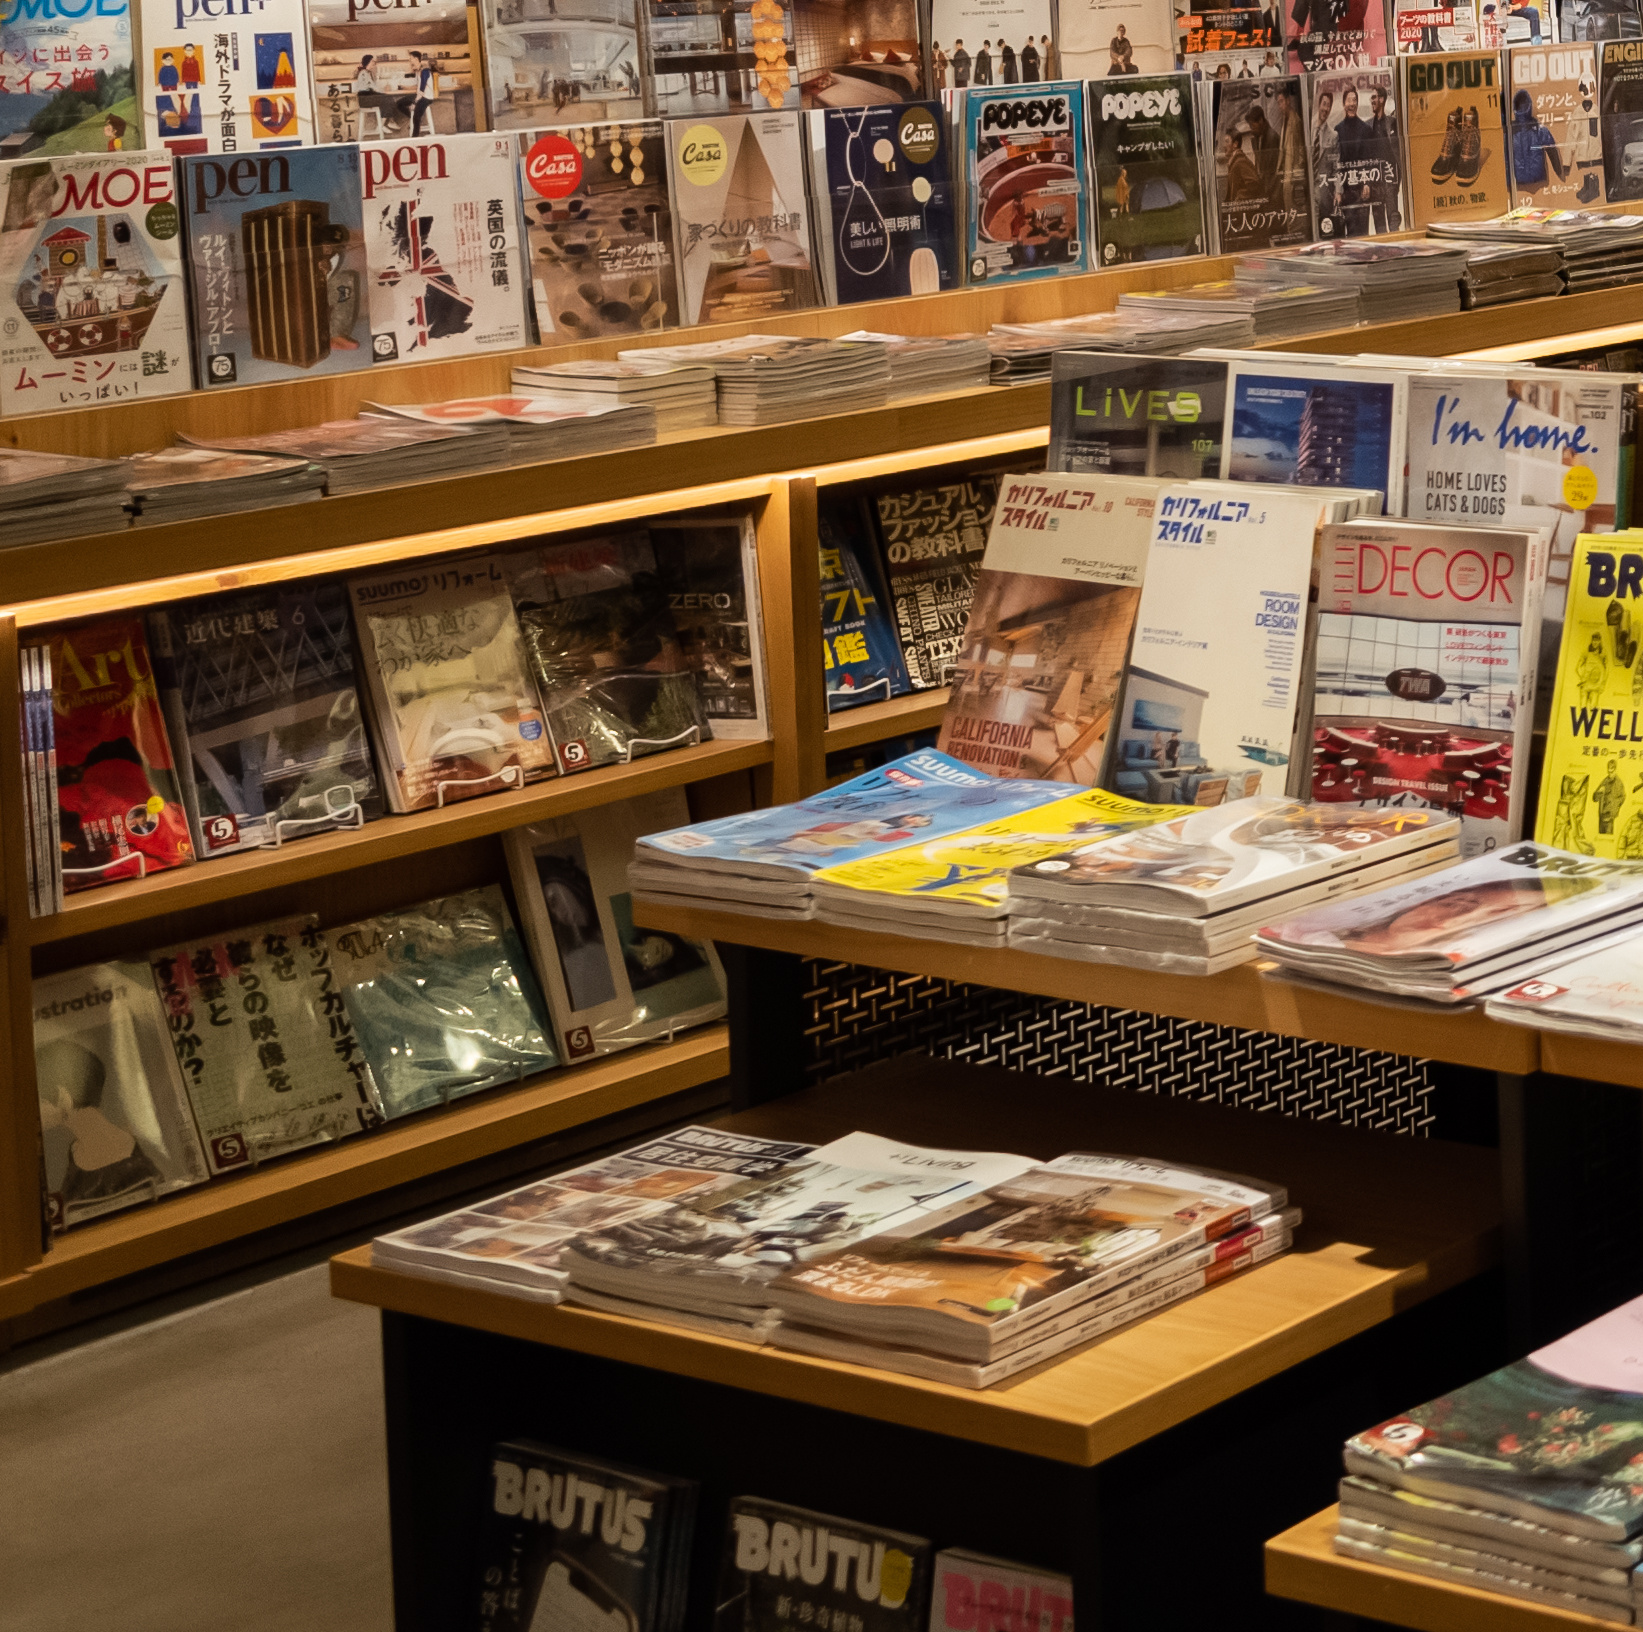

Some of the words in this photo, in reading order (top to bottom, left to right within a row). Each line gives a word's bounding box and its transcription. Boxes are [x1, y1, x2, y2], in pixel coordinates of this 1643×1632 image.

[1409, 60, 1447, 93] GO
[1448, 58, 1495, 90] OUT
[1513, 51, 1551, 83] GO
[982, 98, 1067, 132] POPEYE
[1102, 88, 1182, 120] POPEYE
[900, 121, 937, 147] Casa
[360, 142, 450, 200] pen
[529, 154, 577, 179] Casa
[50, 165, 173, 218] MOE
[194, 153, 293, 215] pen
[1426, 470, 1459, 490] HOME
[1465, 471, 1508, 494] LOVES
[1006, 483, 1096, 512] カリフォルニア
[1162, 495, 1250, 523] カリフォルニア
[1425, 493, 1458, 513] CATS
[1460, 494, 1470, 513] &
[1473, 495, 1506, 515] DOGS
[1000, 506, 1048, 531] スタイル
[1157, 520, 1204, 544] スタイル
[887, 526, 986, 564] の教科書
[1357, 544, 1515, 605] DECOR
[668, 593, 731, 610] ZERO
[1265, 598, 1300, 615] ROOM
[1256, 612, 1299, 630] DESIGN
[950, 716, 1034, 751] CALIFORNIA
[947, 741, 1020, 768] RENOVATION
[493, 1460, 655, 1553] BRUTUS
